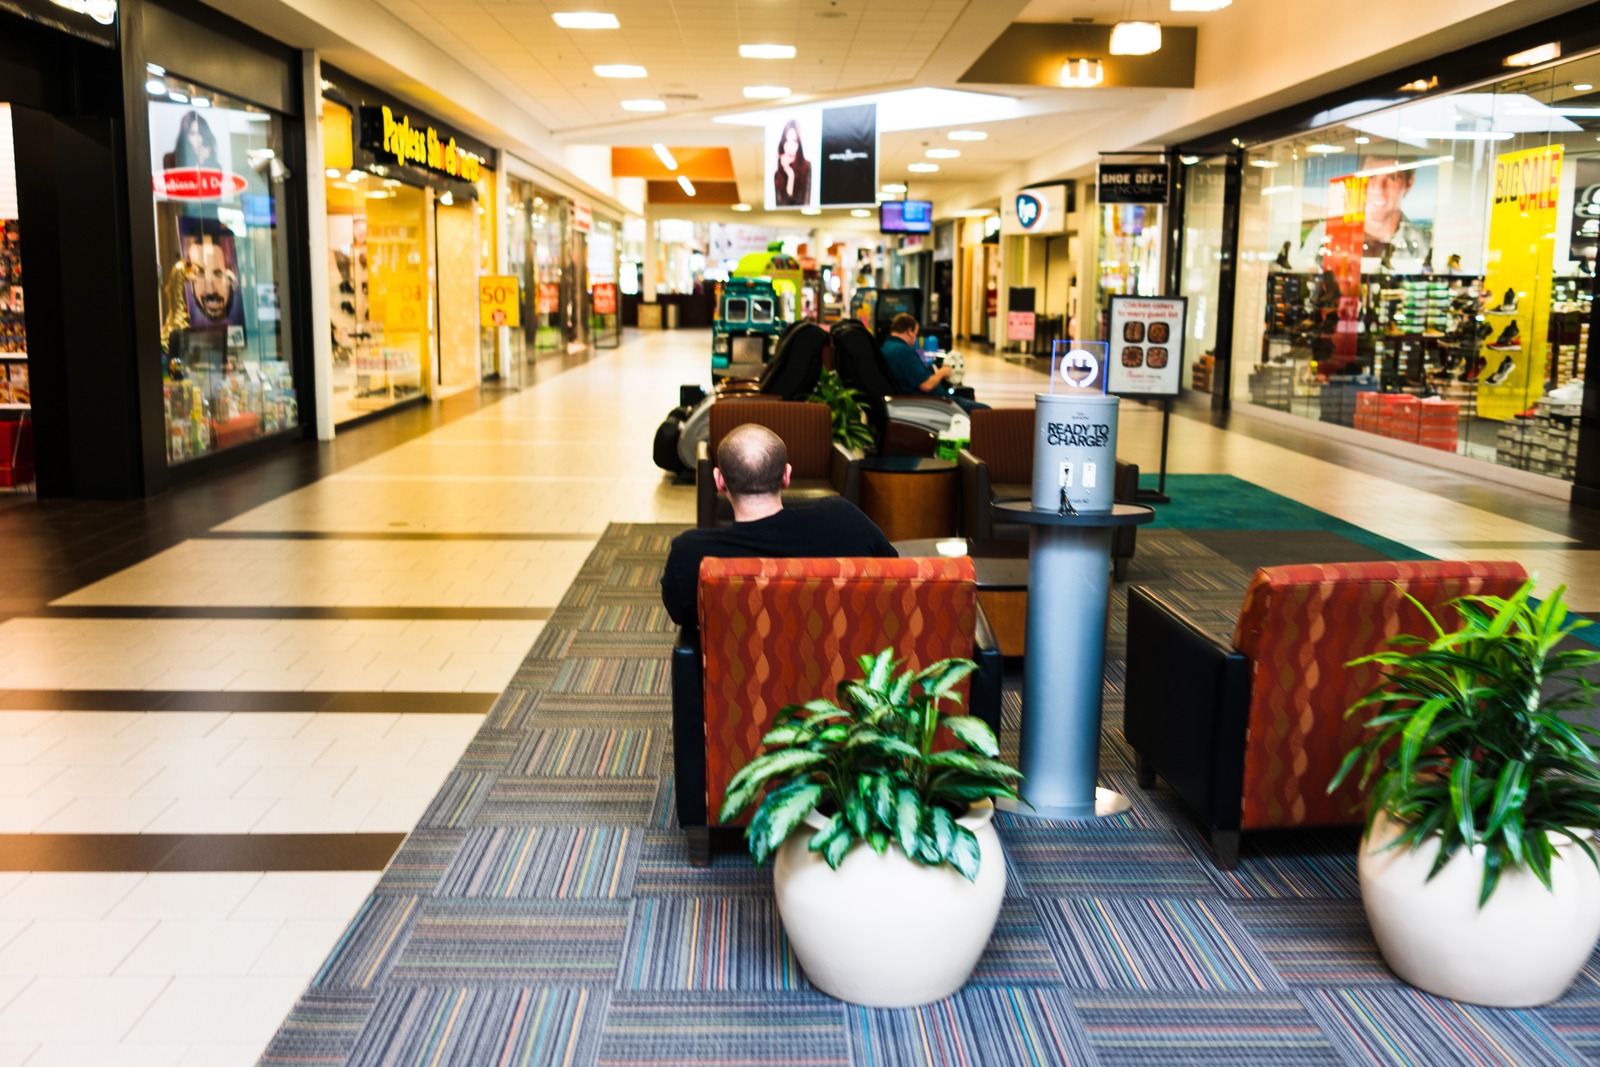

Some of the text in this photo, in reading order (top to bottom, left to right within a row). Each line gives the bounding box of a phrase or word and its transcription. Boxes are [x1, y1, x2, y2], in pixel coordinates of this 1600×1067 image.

[382, 105, 427, 167] Payless
[1101, 174, 1167, 185] SHOE DEPT.
[1496, 153, 1560, 211] BIG SALE
[1123, 301, 1151, 309] Chicken
[1147, 311, 1166, 319] guest
[1047, 422, 1109, 436] READY TO
